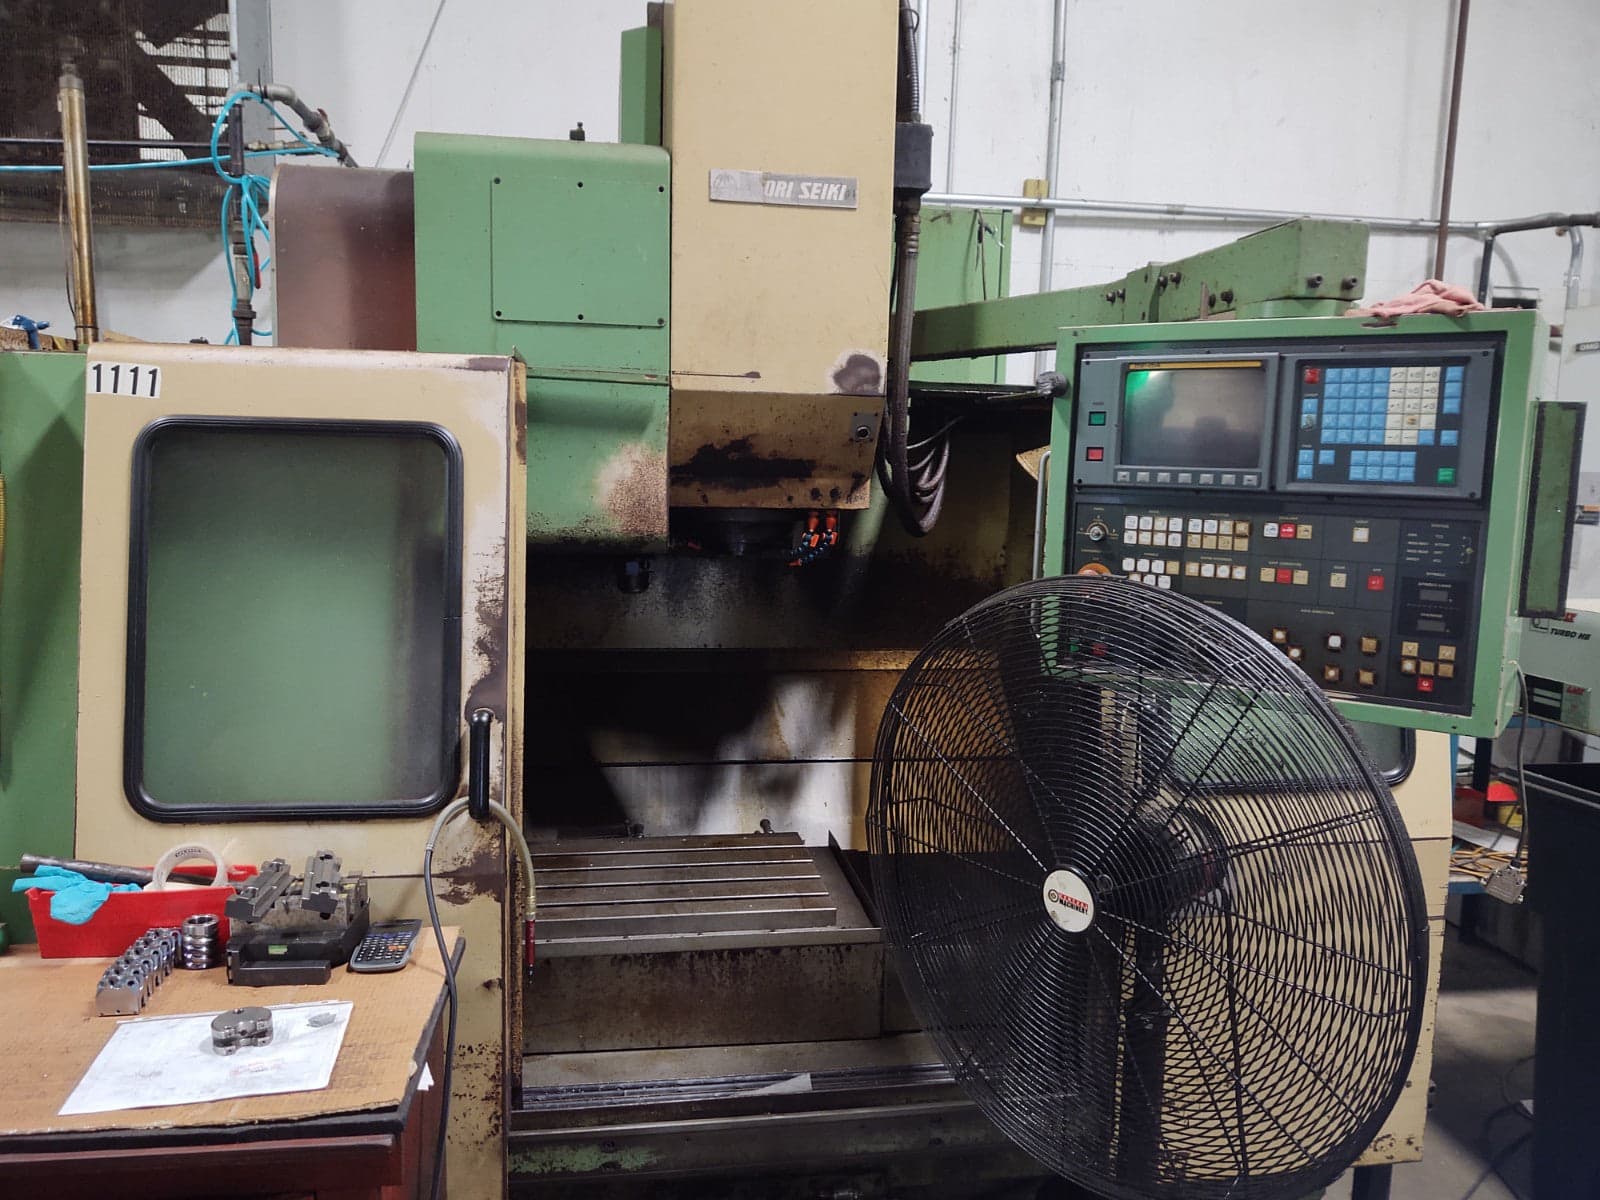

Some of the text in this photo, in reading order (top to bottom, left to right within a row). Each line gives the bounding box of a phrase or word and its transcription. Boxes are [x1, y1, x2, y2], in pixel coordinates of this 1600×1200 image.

[798, 182, 847, 201] SEIKI
[92, 363, 158, 397] 1111
[1060, 898, 1088, 915] MACHINERY
